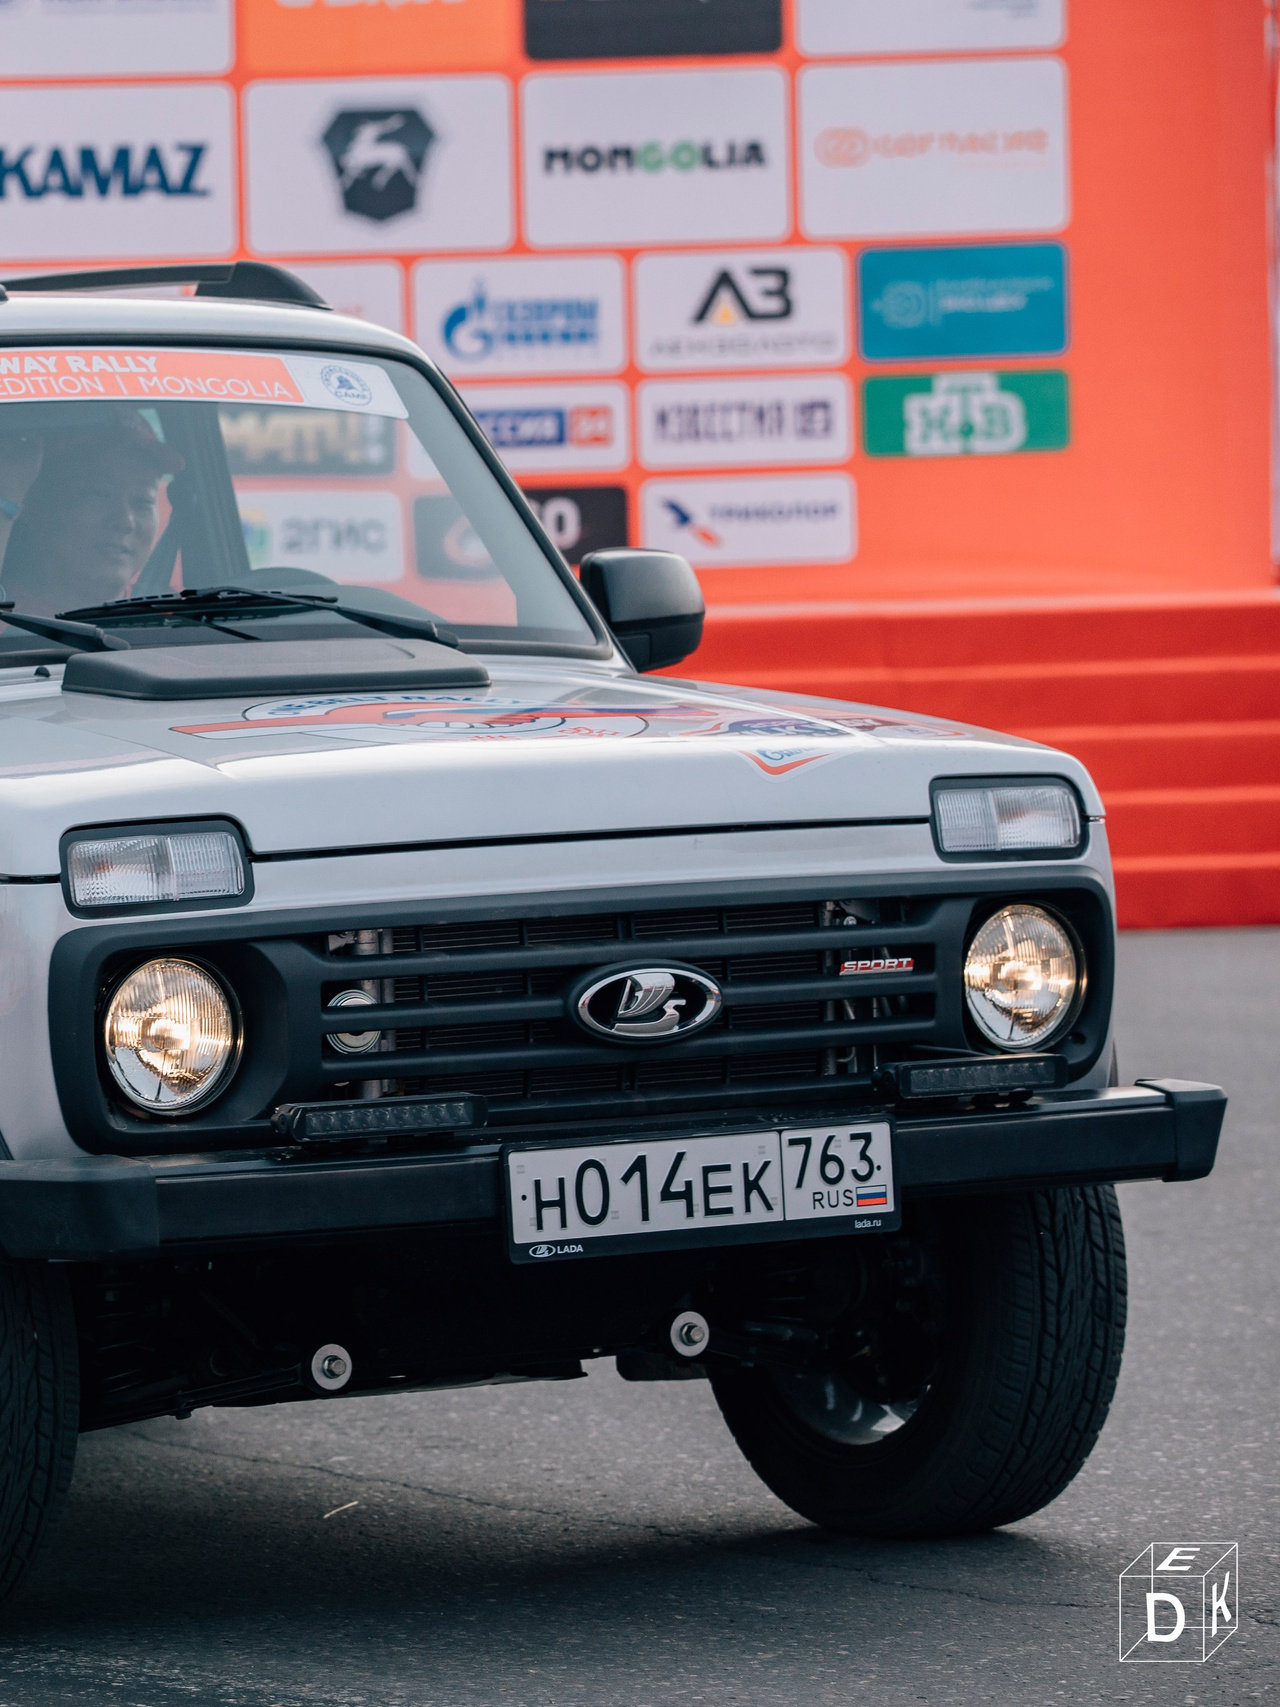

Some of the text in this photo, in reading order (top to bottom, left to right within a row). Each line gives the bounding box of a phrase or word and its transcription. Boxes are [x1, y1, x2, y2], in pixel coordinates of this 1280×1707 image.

[543, 141, 768, 174] MONGOLIA
[70, 356, 159, 374] RALLY
[139, 376, 294, 399] MONGOLIA
[843, 958, 911, 973] SPORT
[787, 1132, 876, 1189] 763
[812, 1189, 854, 1210] RUS
[853, 1218, 882, 1229] lada.ru
[556, 1244, 584, 1255] LADA
